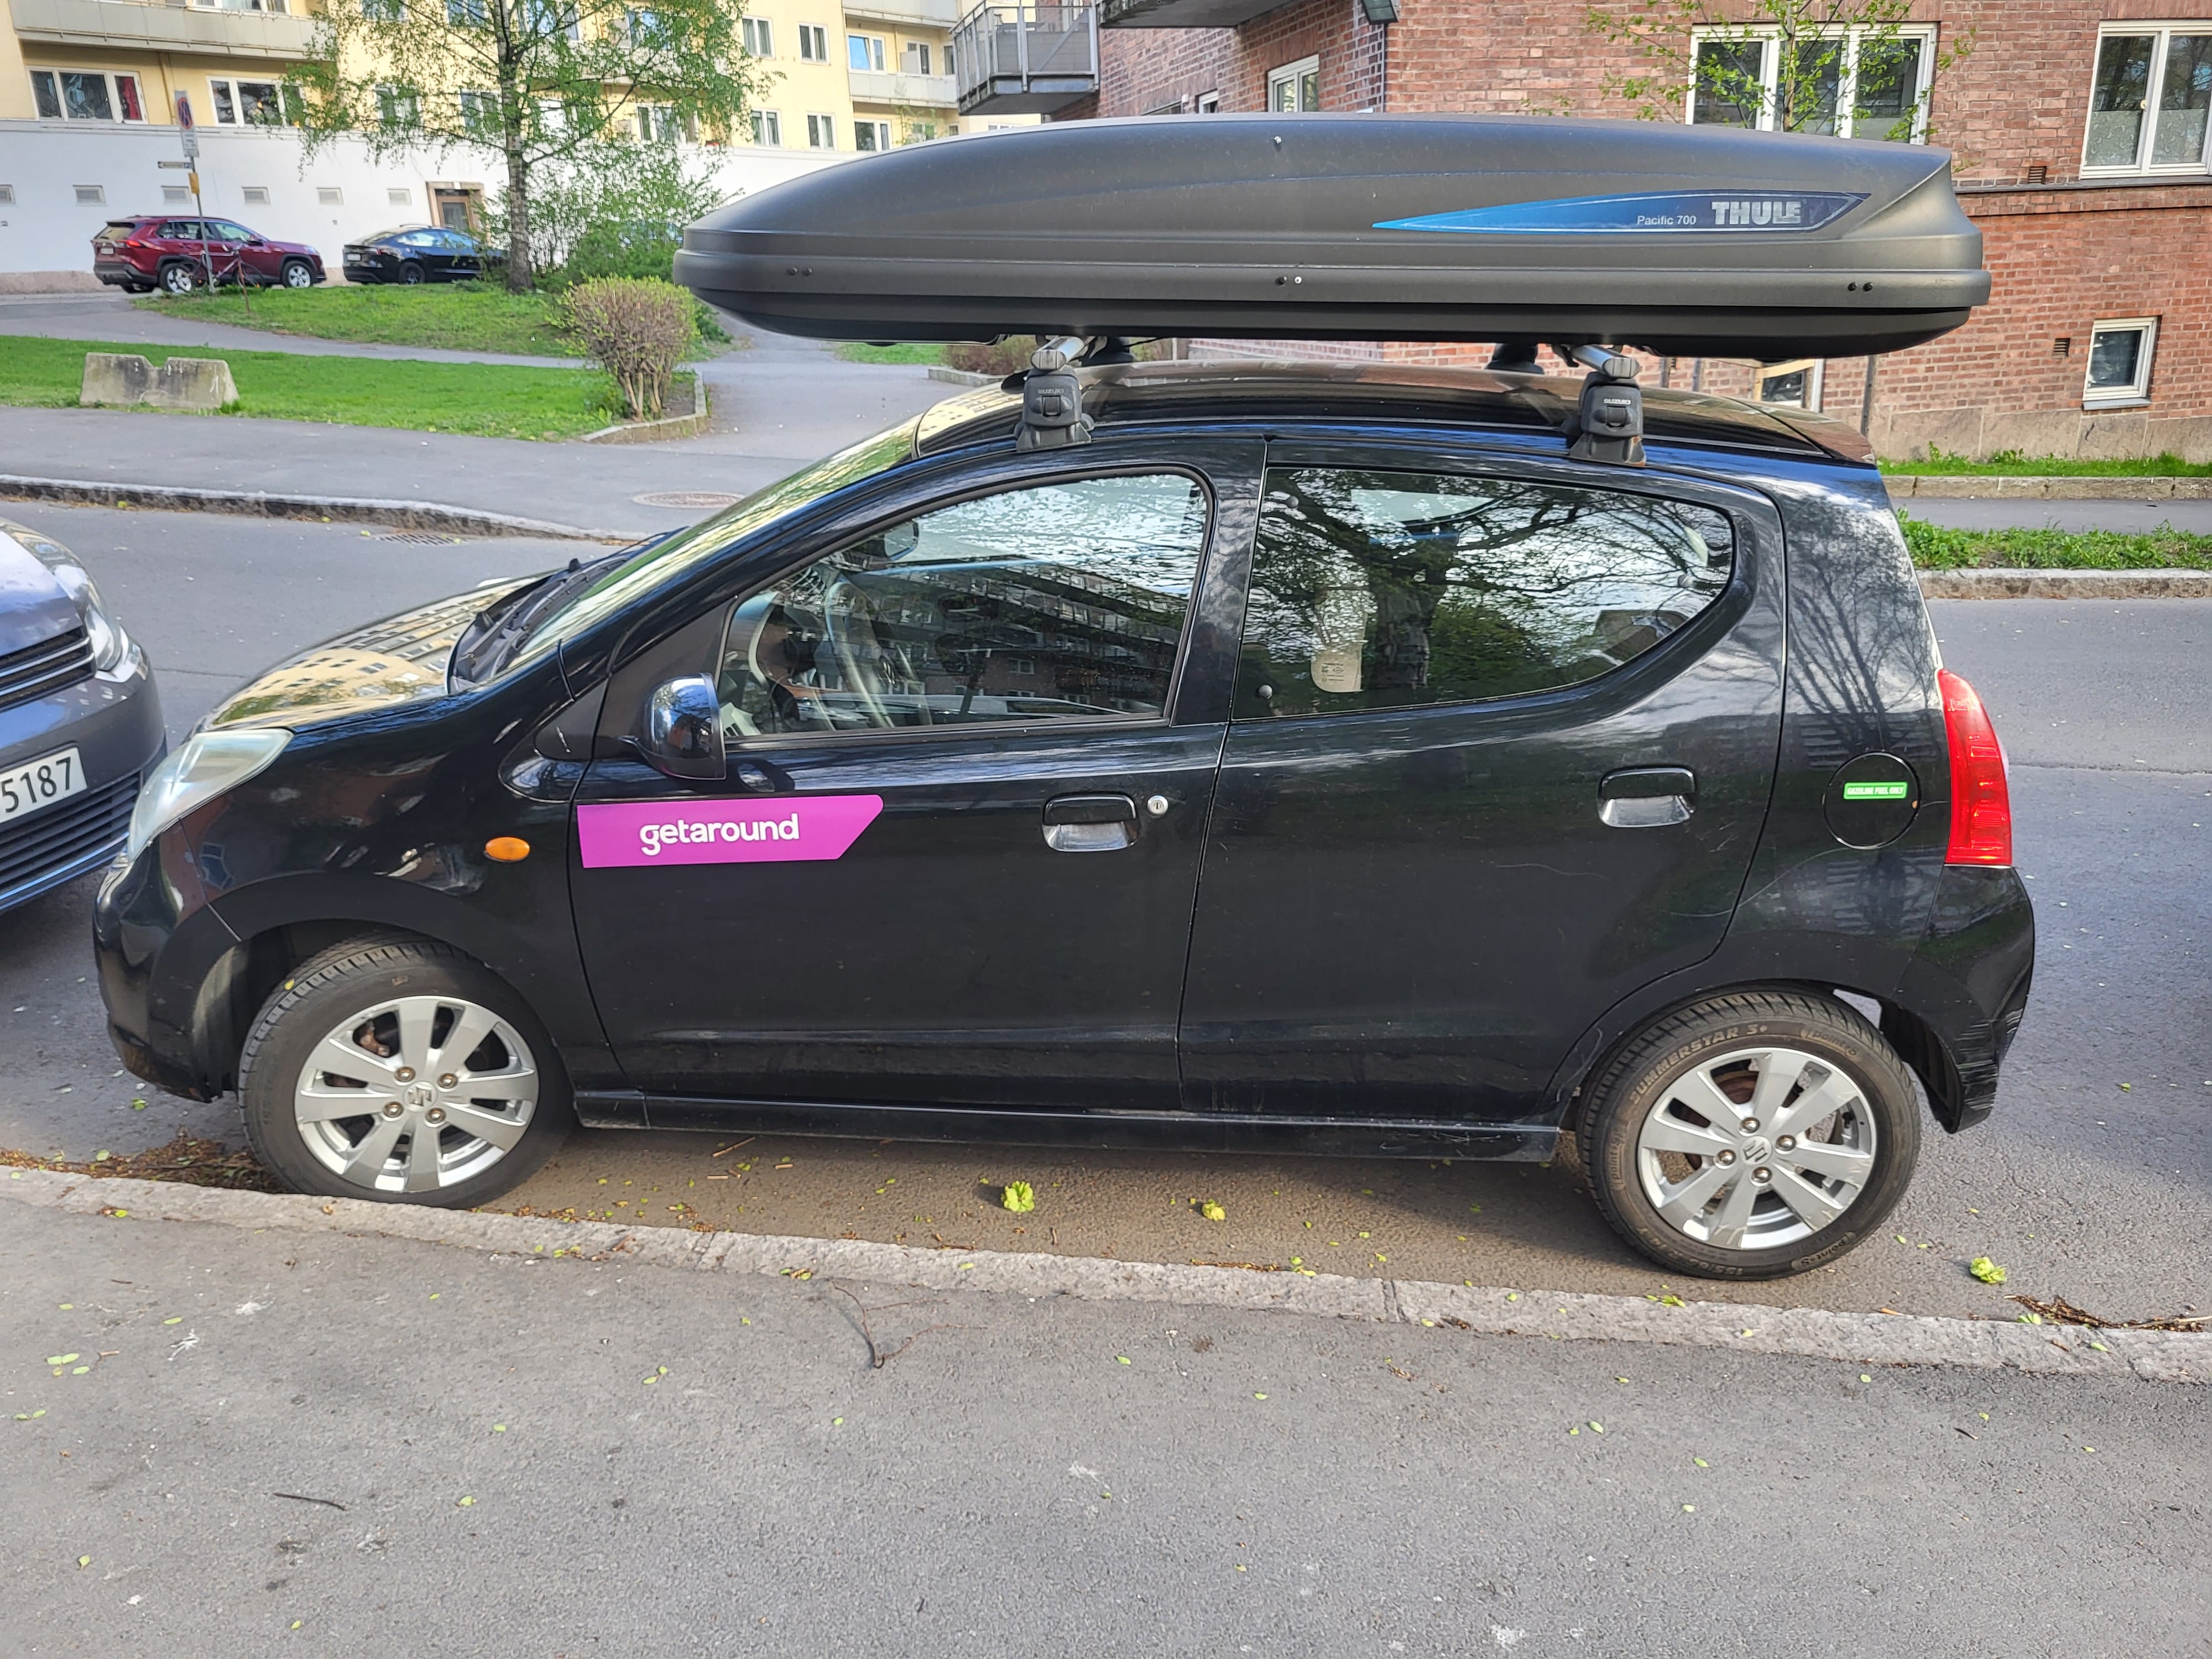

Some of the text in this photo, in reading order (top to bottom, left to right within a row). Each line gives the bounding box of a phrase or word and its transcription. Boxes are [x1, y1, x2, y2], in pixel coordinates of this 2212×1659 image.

[1636, 215, 1697, 226] Pacific 700
[1710, 201, 1802, 226] THULE
[639, 813, 800, 857] getaround
[1629, 1026, 1739, 1104] SUMMERSTAR
